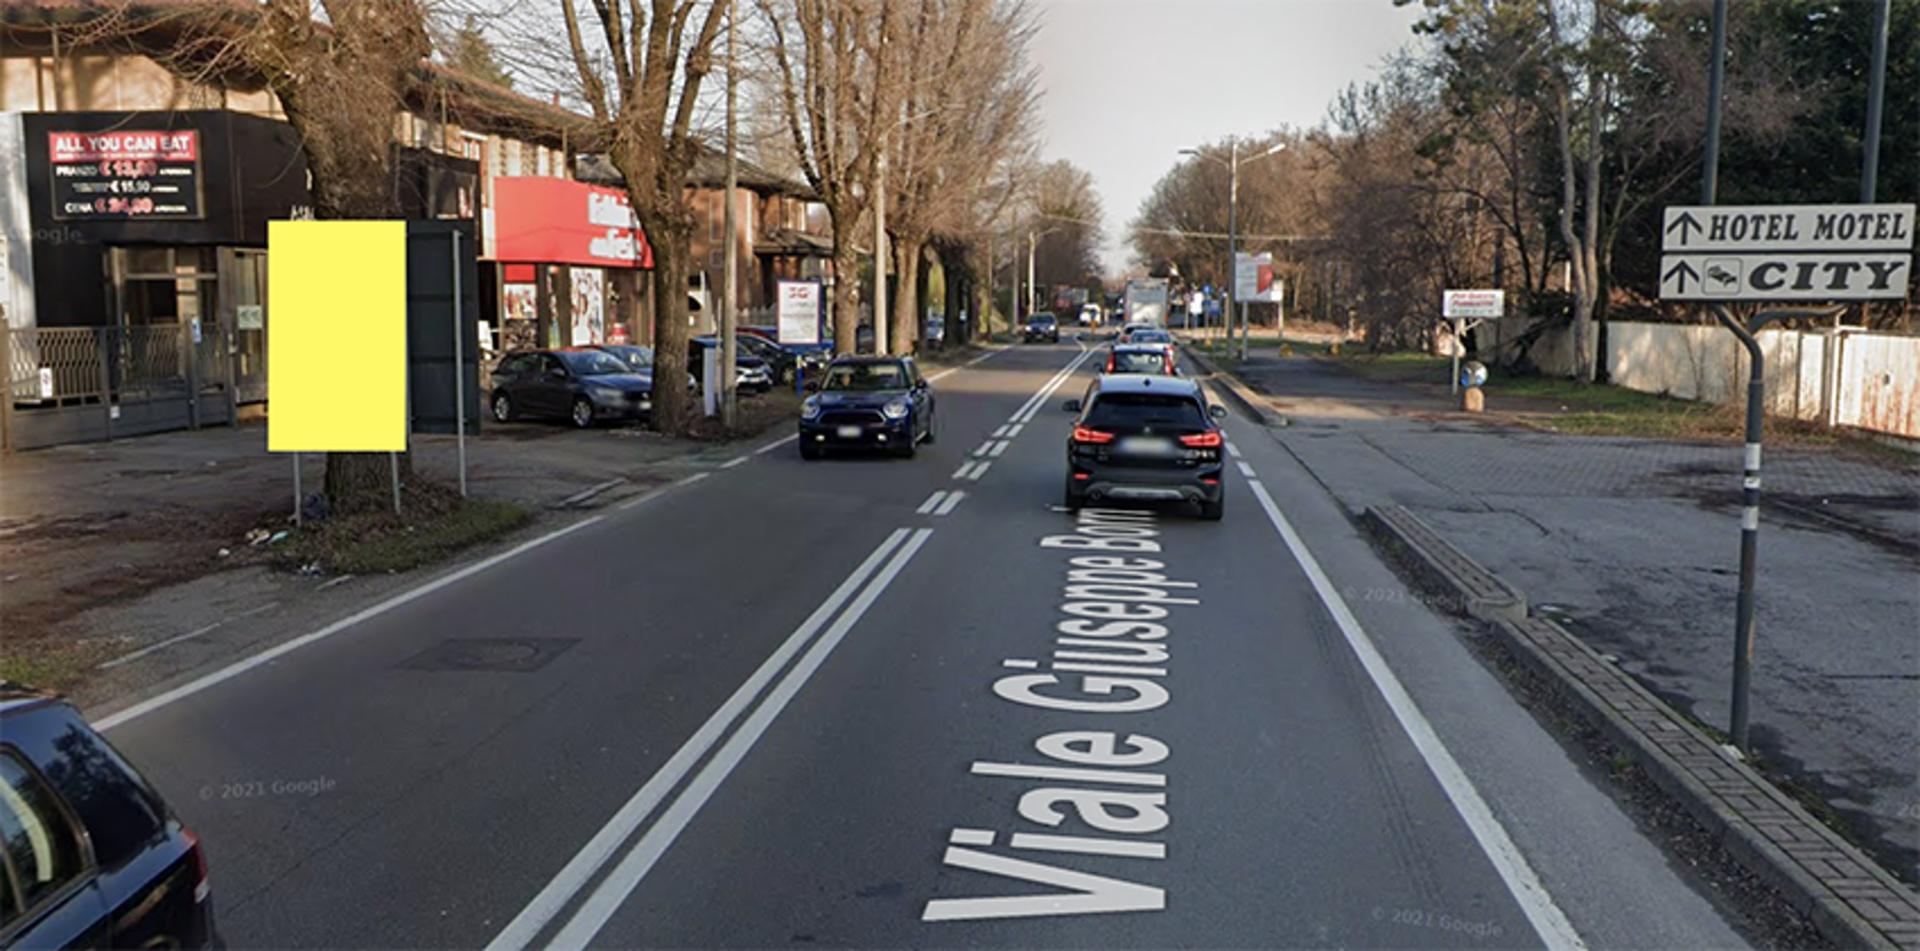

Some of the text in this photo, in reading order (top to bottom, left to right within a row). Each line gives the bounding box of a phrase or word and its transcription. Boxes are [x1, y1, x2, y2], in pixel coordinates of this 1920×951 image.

[56, 135, 189, 151] ALL YOU CAN EAT
[55, 165, 98, 176] PRANZO
[64, 203, 93, 213] CENA
[1708, 213, 1907, 241] HOTEL MOTEL
[1749, 262, 1905, 291] CITY
